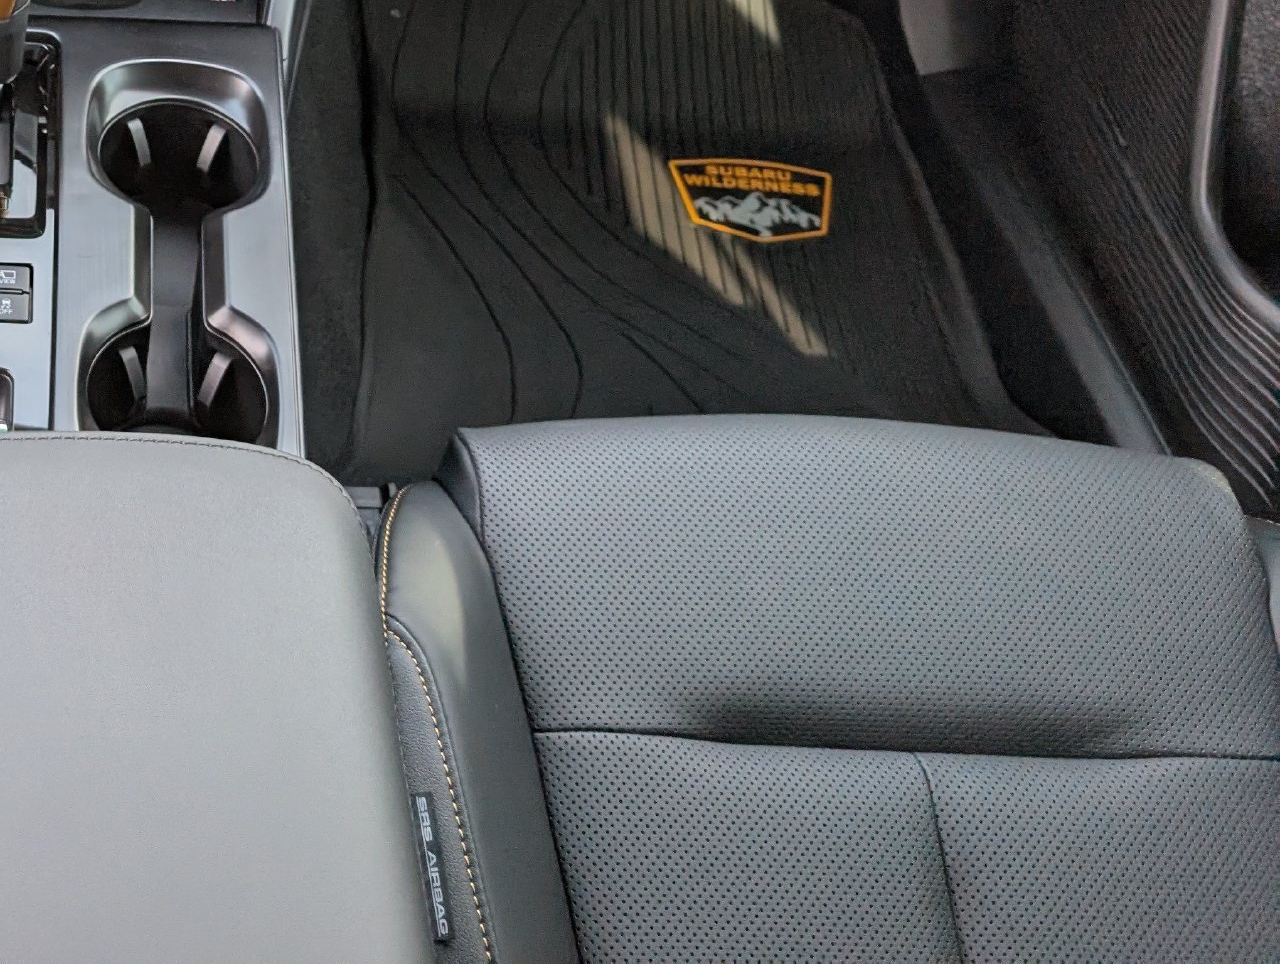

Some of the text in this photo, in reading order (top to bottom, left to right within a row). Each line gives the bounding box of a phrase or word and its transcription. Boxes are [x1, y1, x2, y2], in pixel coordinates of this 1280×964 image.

[705, 164, 792, 181] SUBARU
[683, 173, 820, 197] WILDERNESS
[417, 796, 449, 935] SRS AIRBAG
